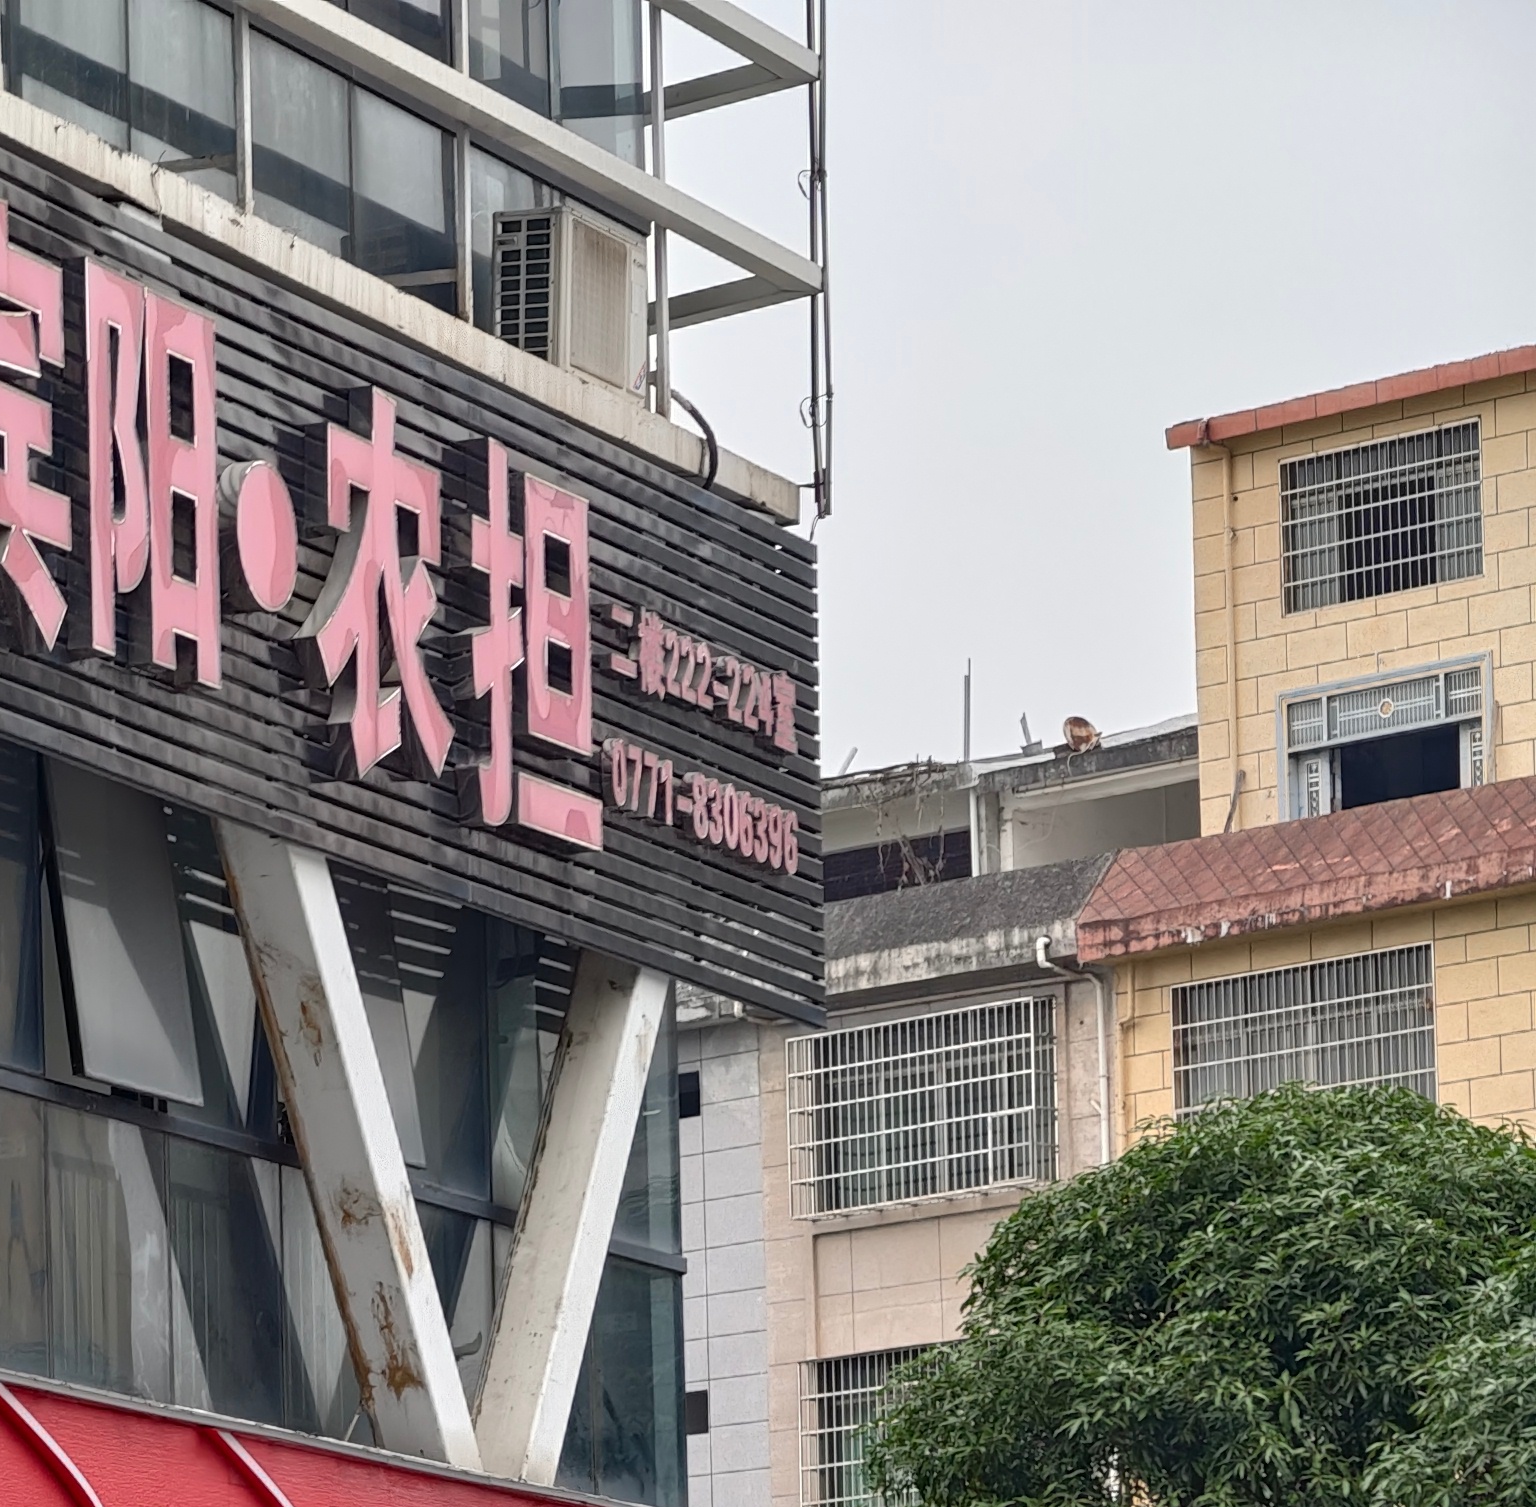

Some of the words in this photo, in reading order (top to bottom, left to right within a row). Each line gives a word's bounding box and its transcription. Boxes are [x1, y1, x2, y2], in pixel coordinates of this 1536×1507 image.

[610, 604, 798, 754] 二楼222-224室
[606, 738, 799, 875] 0771-8306396
